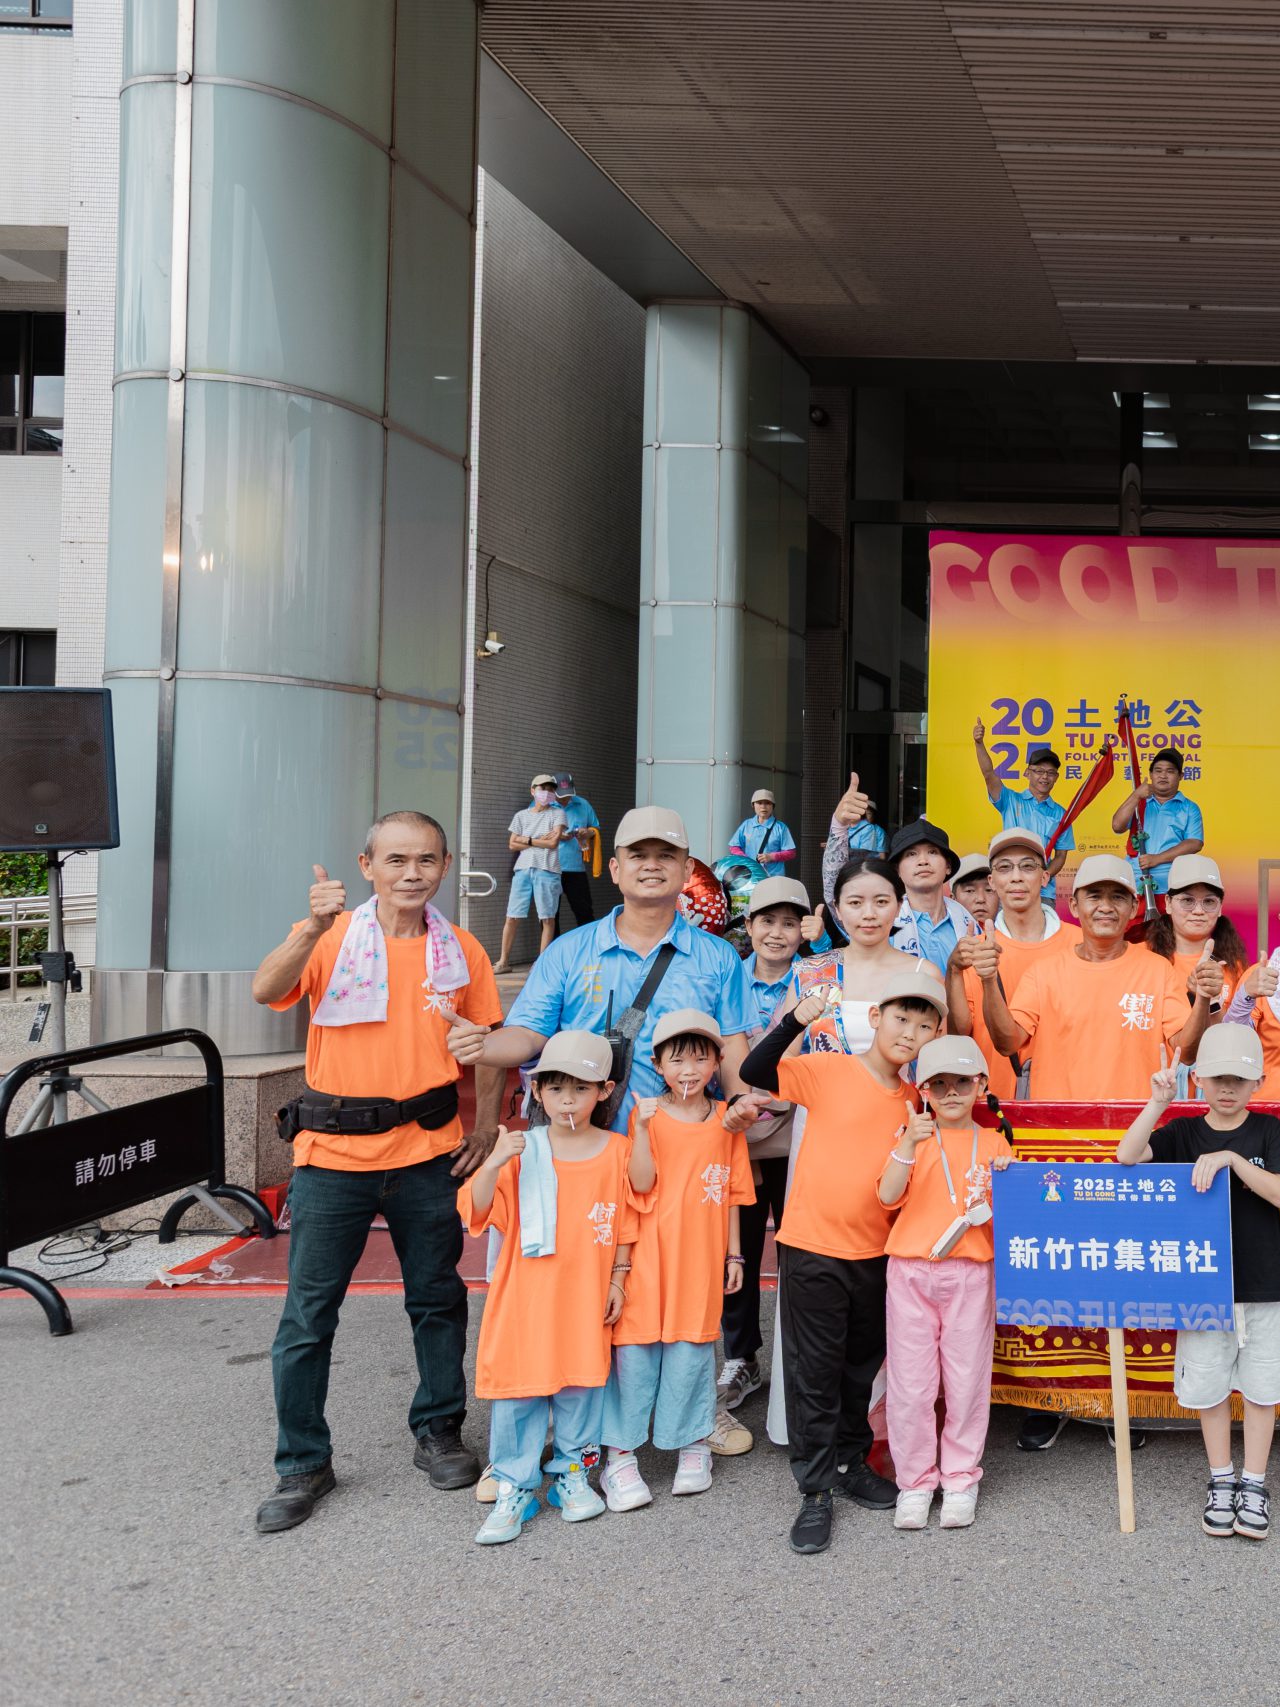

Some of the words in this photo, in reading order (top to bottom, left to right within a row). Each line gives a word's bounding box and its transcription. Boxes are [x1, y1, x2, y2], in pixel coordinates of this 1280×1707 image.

[929, 542, 1190, 622] GOOD
[990, 698, 1054, 736] 20
[1064, 699, 1203, 728] 土地公
[1066, 733, 1094, 748] TU
[1136, 733, 1202, 749] GONG
[75, 1139, 157, 1186] 請勿停車
[1073, 1178, 1115, 1191] 2025
[1117, 1178, 1177, 1193] 土地公
[1008, 1236, 1219, 1273] 新竹市集福社
